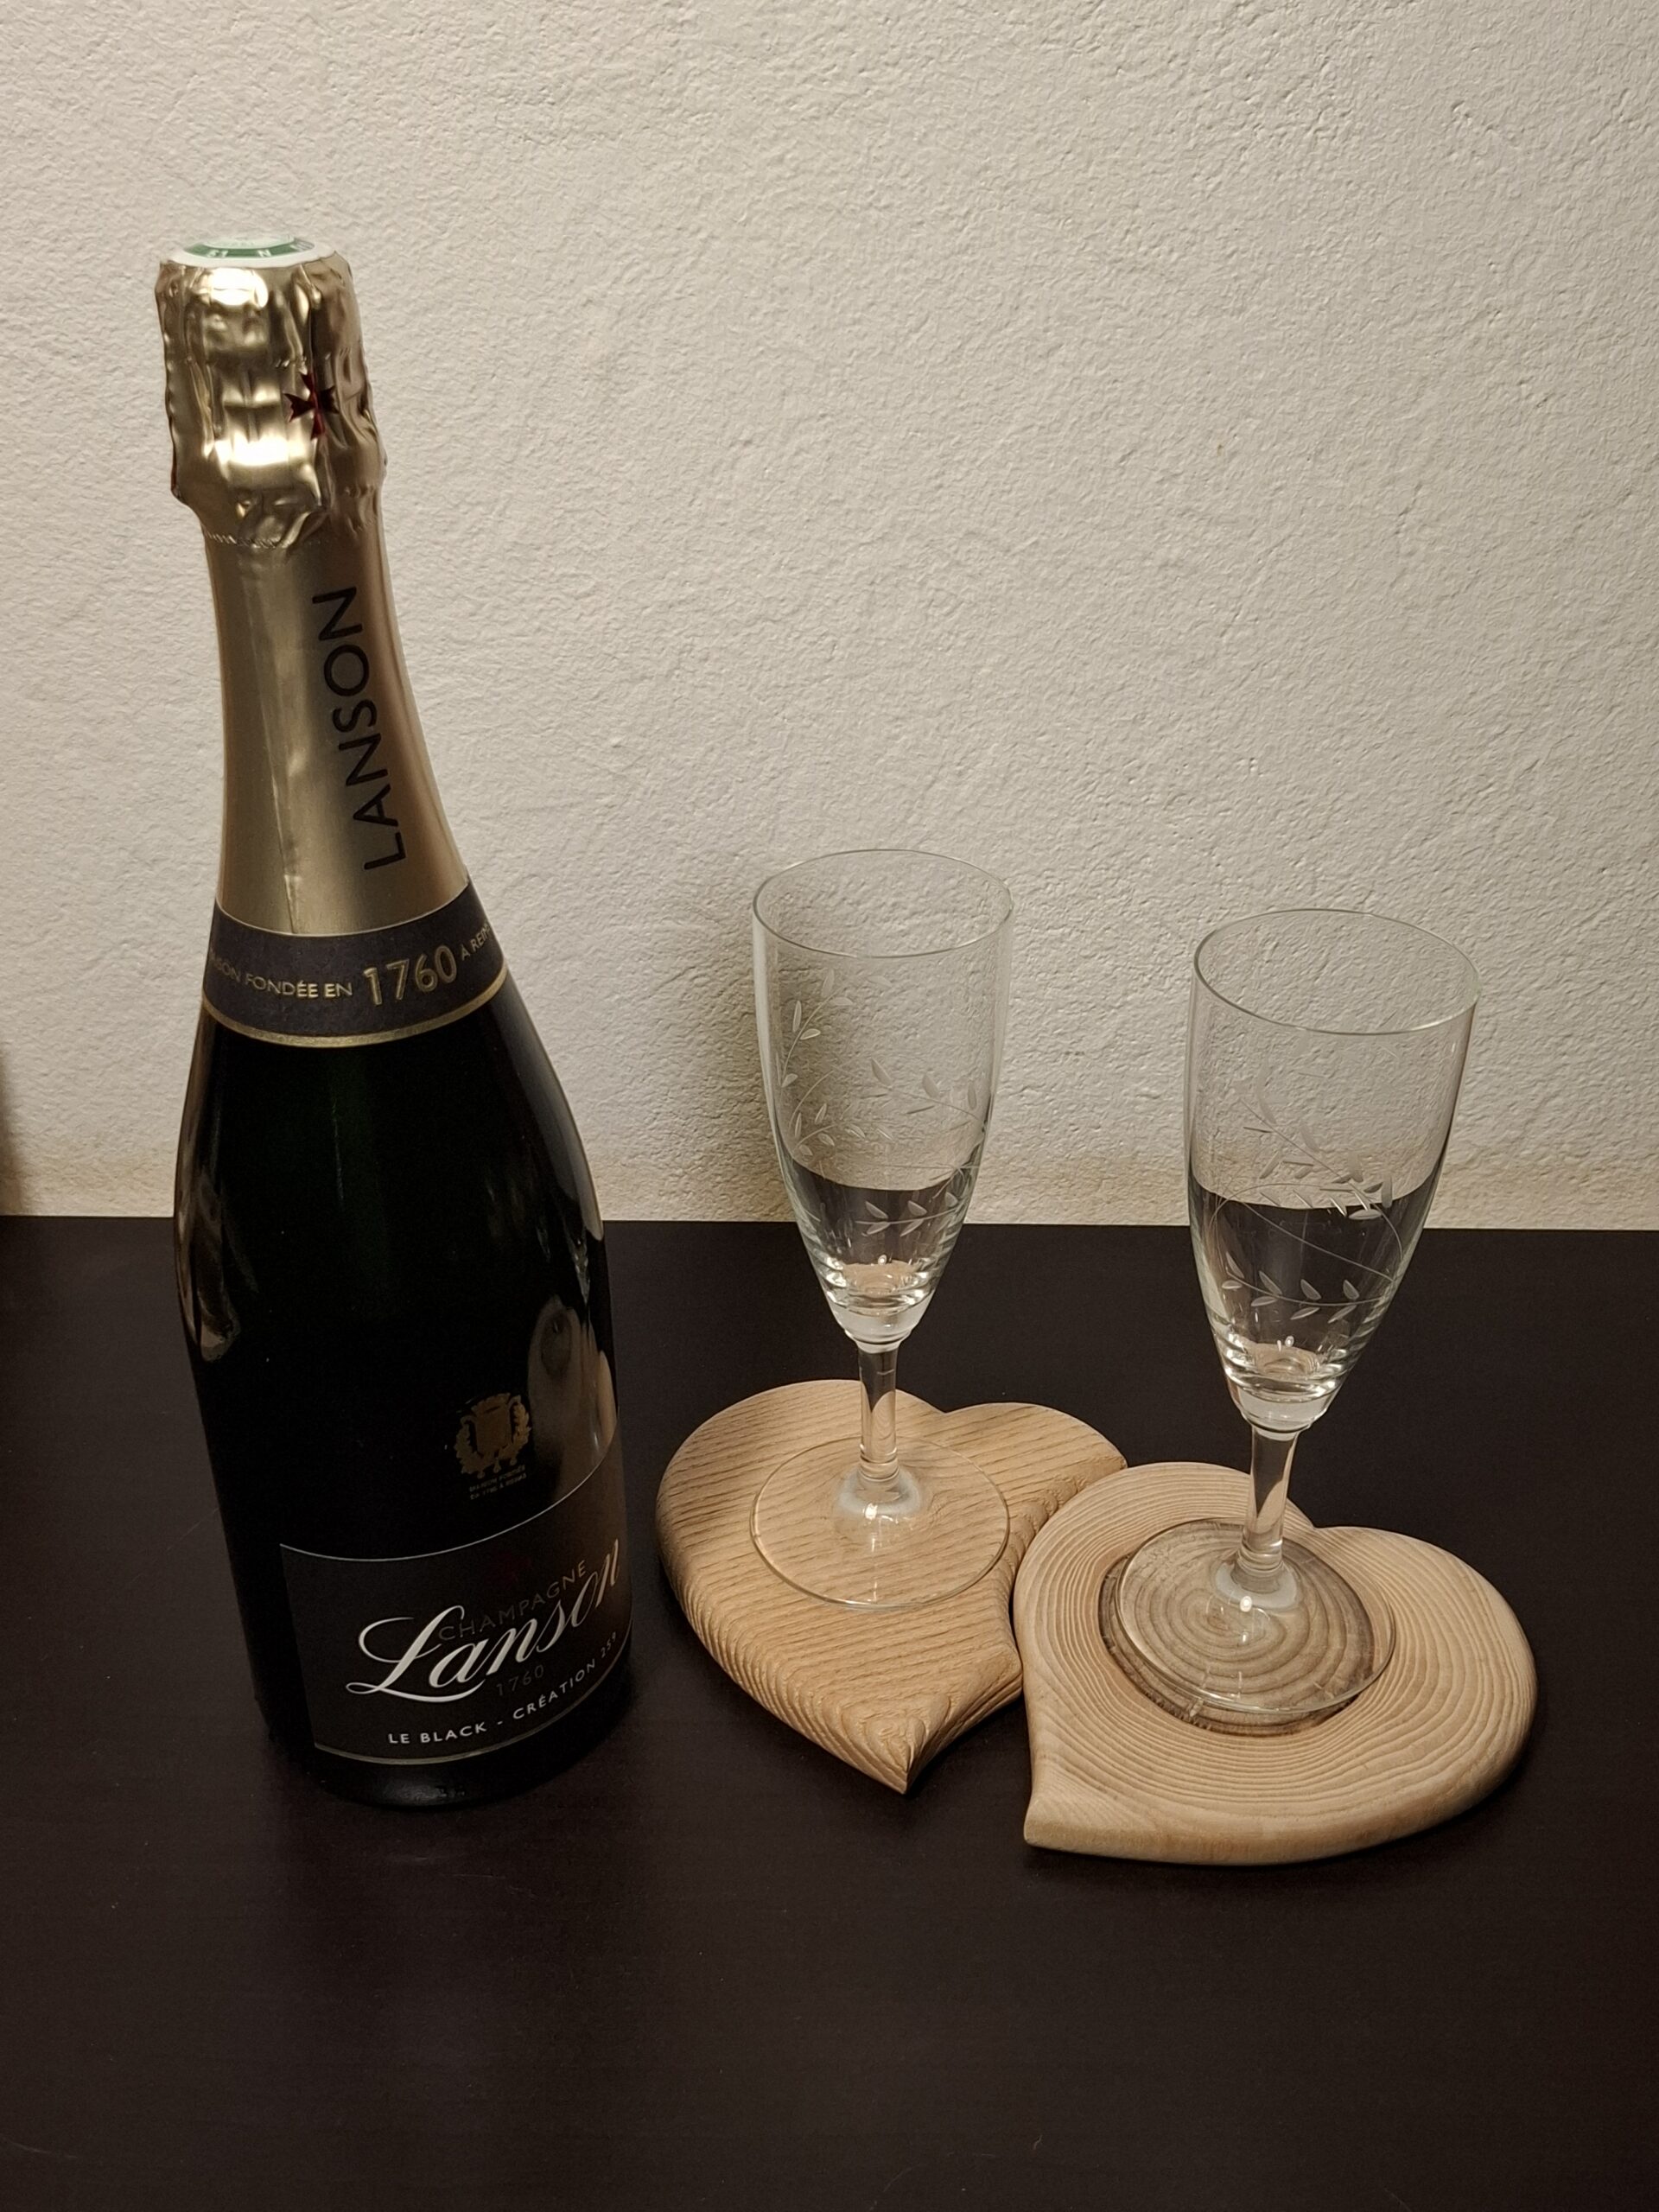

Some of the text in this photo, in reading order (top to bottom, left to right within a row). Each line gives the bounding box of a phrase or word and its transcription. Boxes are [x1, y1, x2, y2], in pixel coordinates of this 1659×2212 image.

[312, 586, 406, 870] LANSON
[245, 973, 319, 998] FONDÉE
[324, 982, 353, 997] EN
[363, 944, 458, 1007] 1760
[346, 1538, 620, 1703] Lanson
[438, 1559, 588, 1642] CHAMPAGNE
[388, 1732, 410, 1745] LE
[420, 1721, 487, 1745] BLACK
[512, 1657, 597, 1720] CRÉATION
[495, 1664, 545, 1697] 1760
